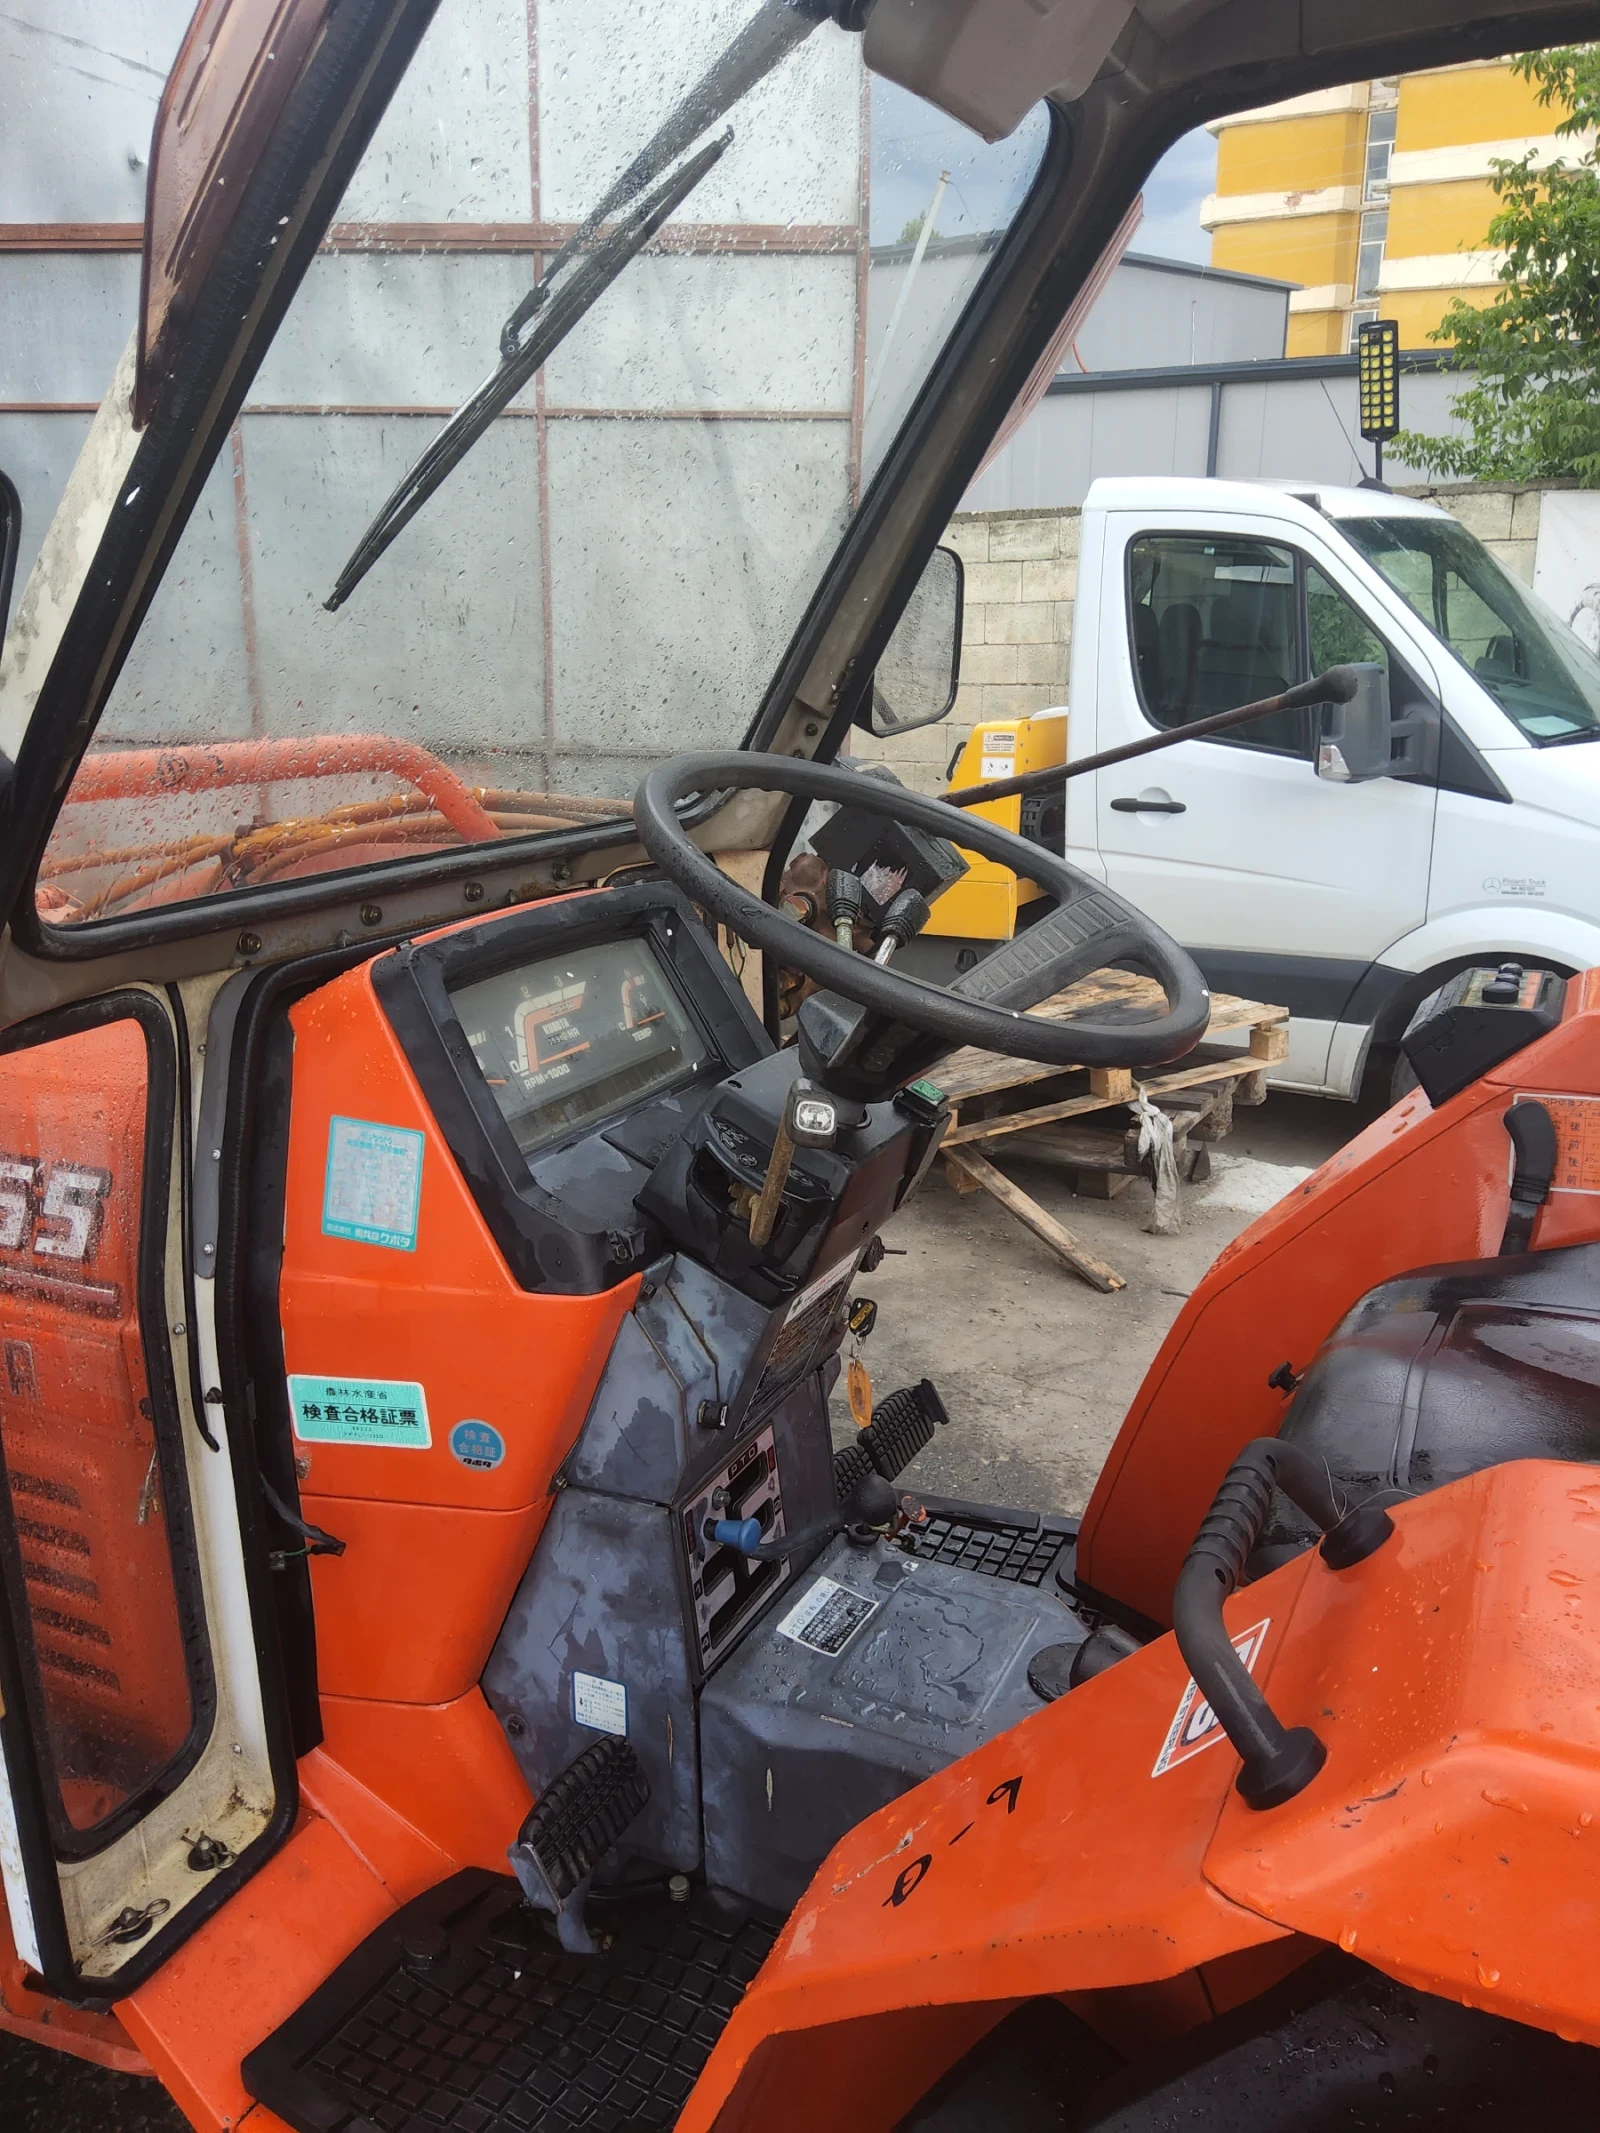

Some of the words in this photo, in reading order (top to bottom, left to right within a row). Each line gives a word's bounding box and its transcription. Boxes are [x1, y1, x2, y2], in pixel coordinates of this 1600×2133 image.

[553, 975, 564, 988] 3
[520, 985, 532, 998] 2
[504, 1025, 515, 1038] 1
[567, 1027, 580, 1039] HR
[632, 1028, 653, 1042] TEMP
[509, 1060, 520, 1074] 0
[325, 1387, 388, 1400] 農林水産省
[302, 1403, 419, 1427] 検査合格証票
[730, 1449, 757, 1479] PTO
[1156, 1703, 1189, 1773] STEERING
